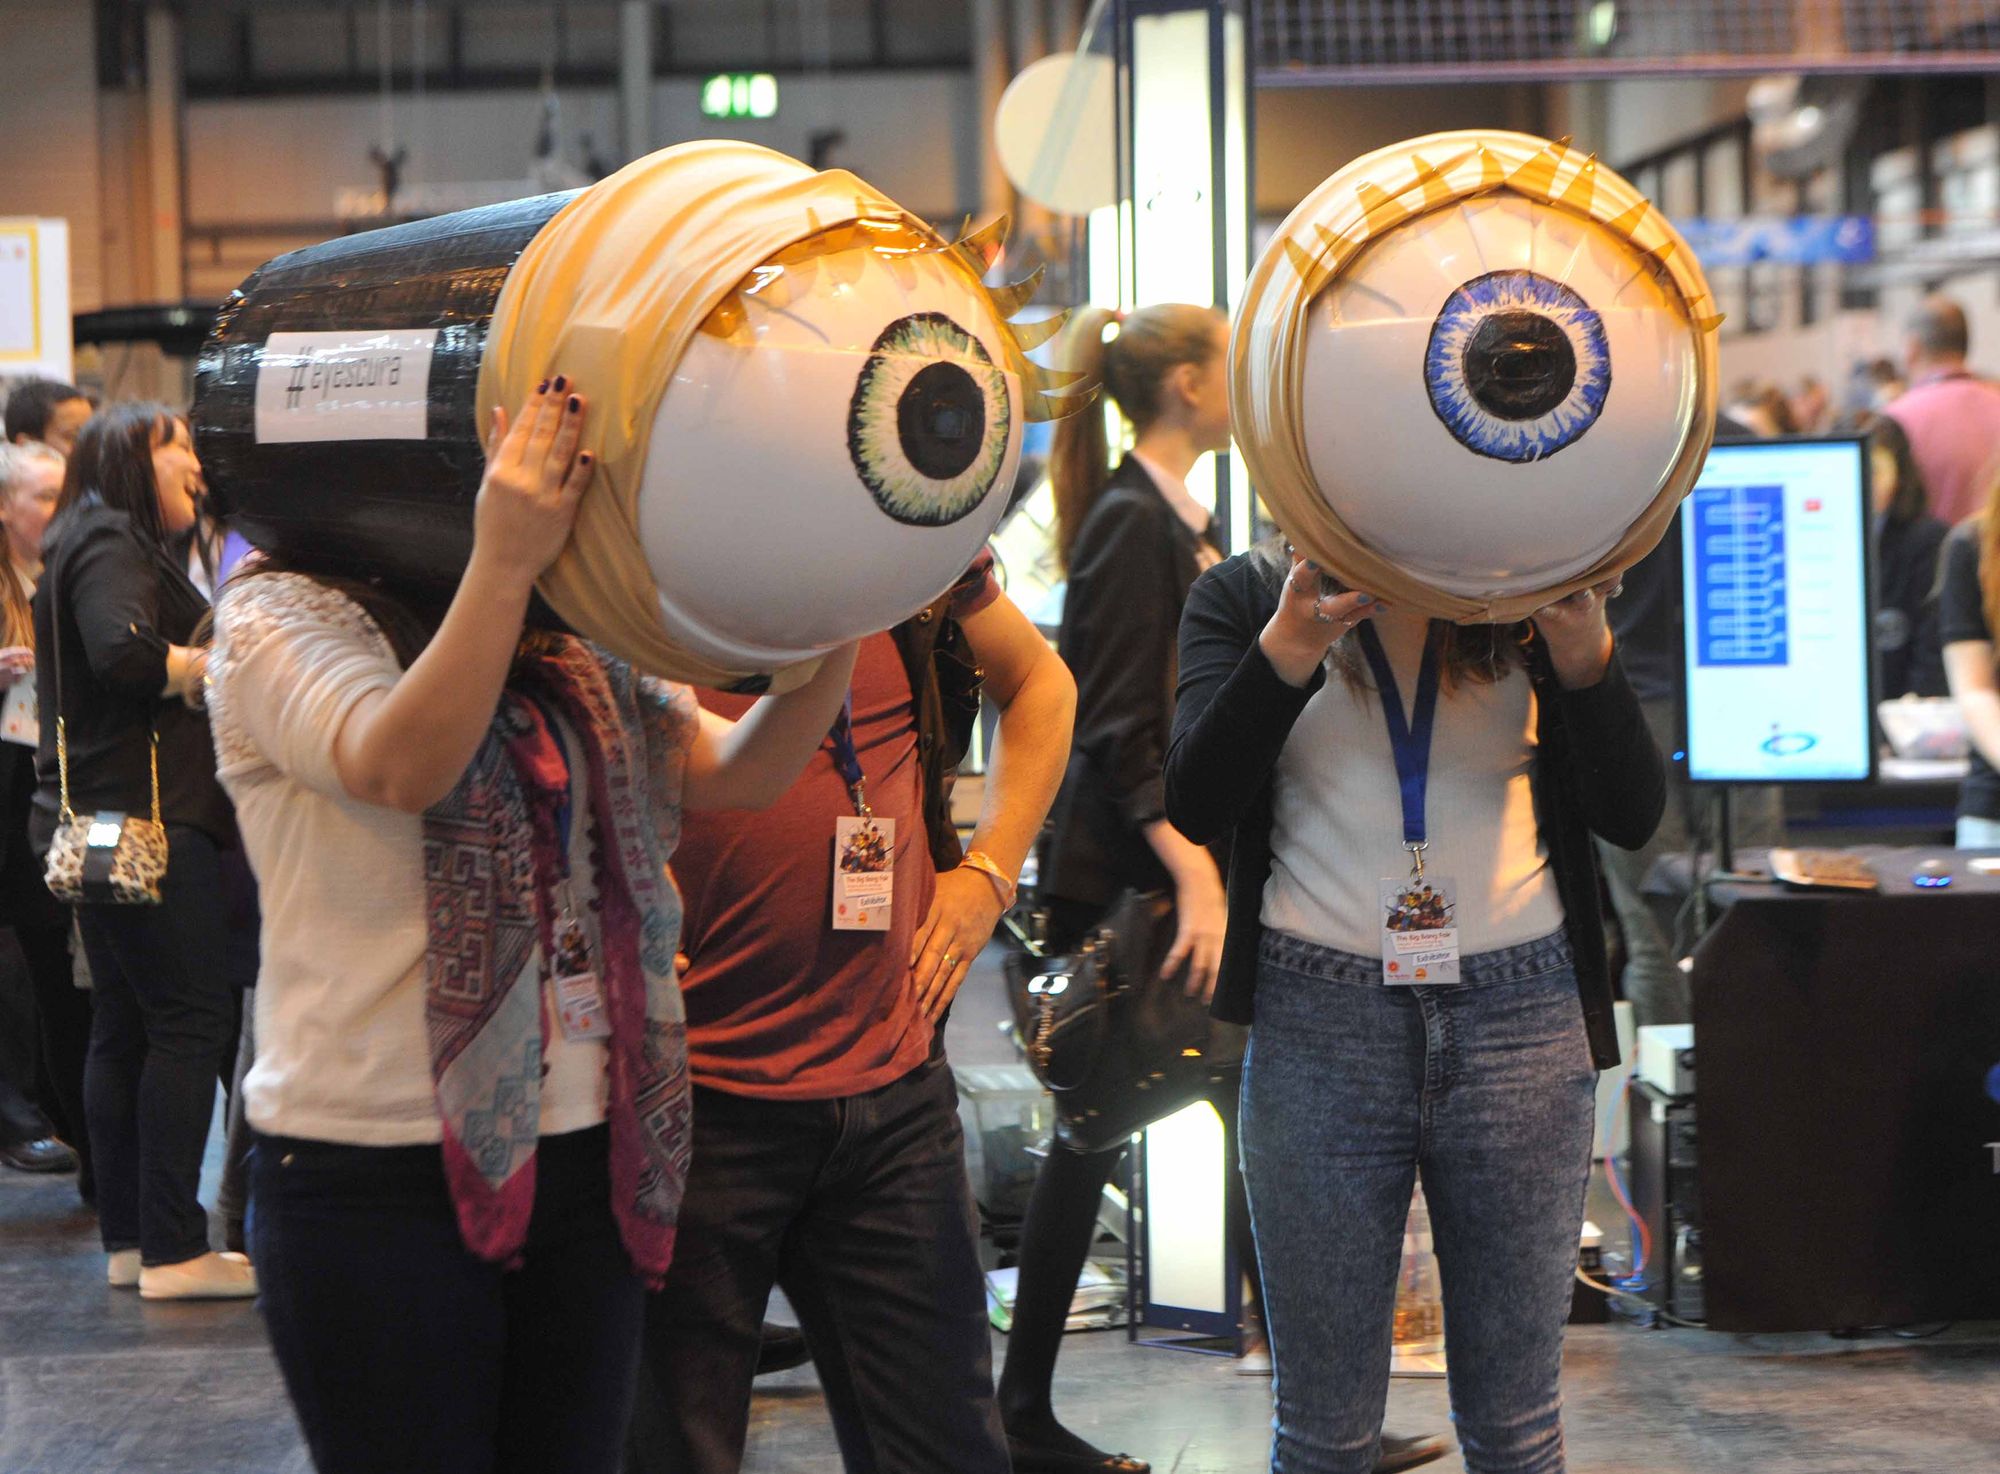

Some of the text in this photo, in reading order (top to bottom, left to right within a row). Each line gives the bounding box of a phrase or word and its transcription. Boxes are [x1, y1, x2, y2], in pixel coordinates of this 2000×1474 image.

[286, 345, 401, 410] #eyescura
[860, 896, 887, 906] Exhibitor
[1416, 952, 1450, 962] Exhibitor
